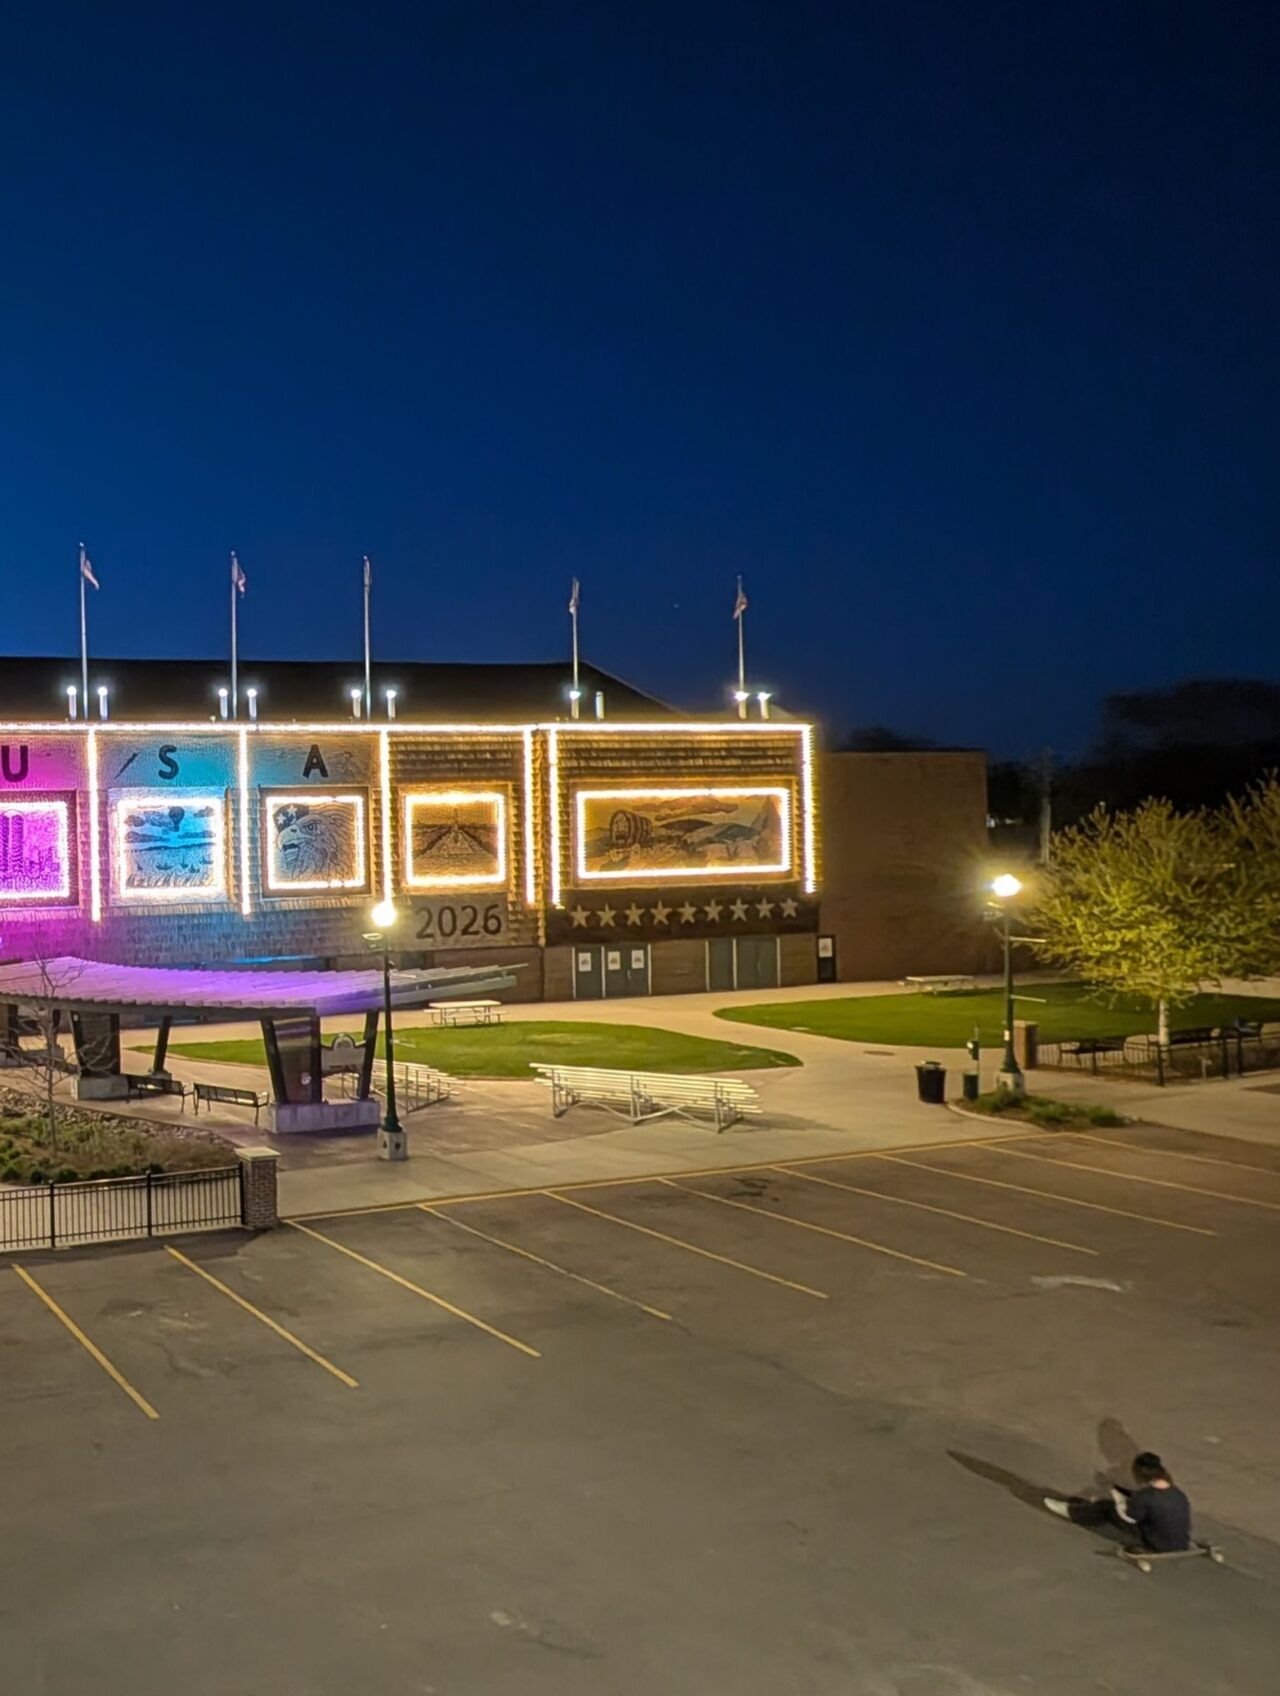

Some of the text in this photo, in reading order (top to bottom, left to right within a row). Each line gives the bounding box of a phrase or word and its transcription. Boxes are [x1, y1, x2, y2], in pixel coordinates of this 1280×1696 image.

[1, 744, 328, 782] U S A
[415, 904, 502, 938] 2026
